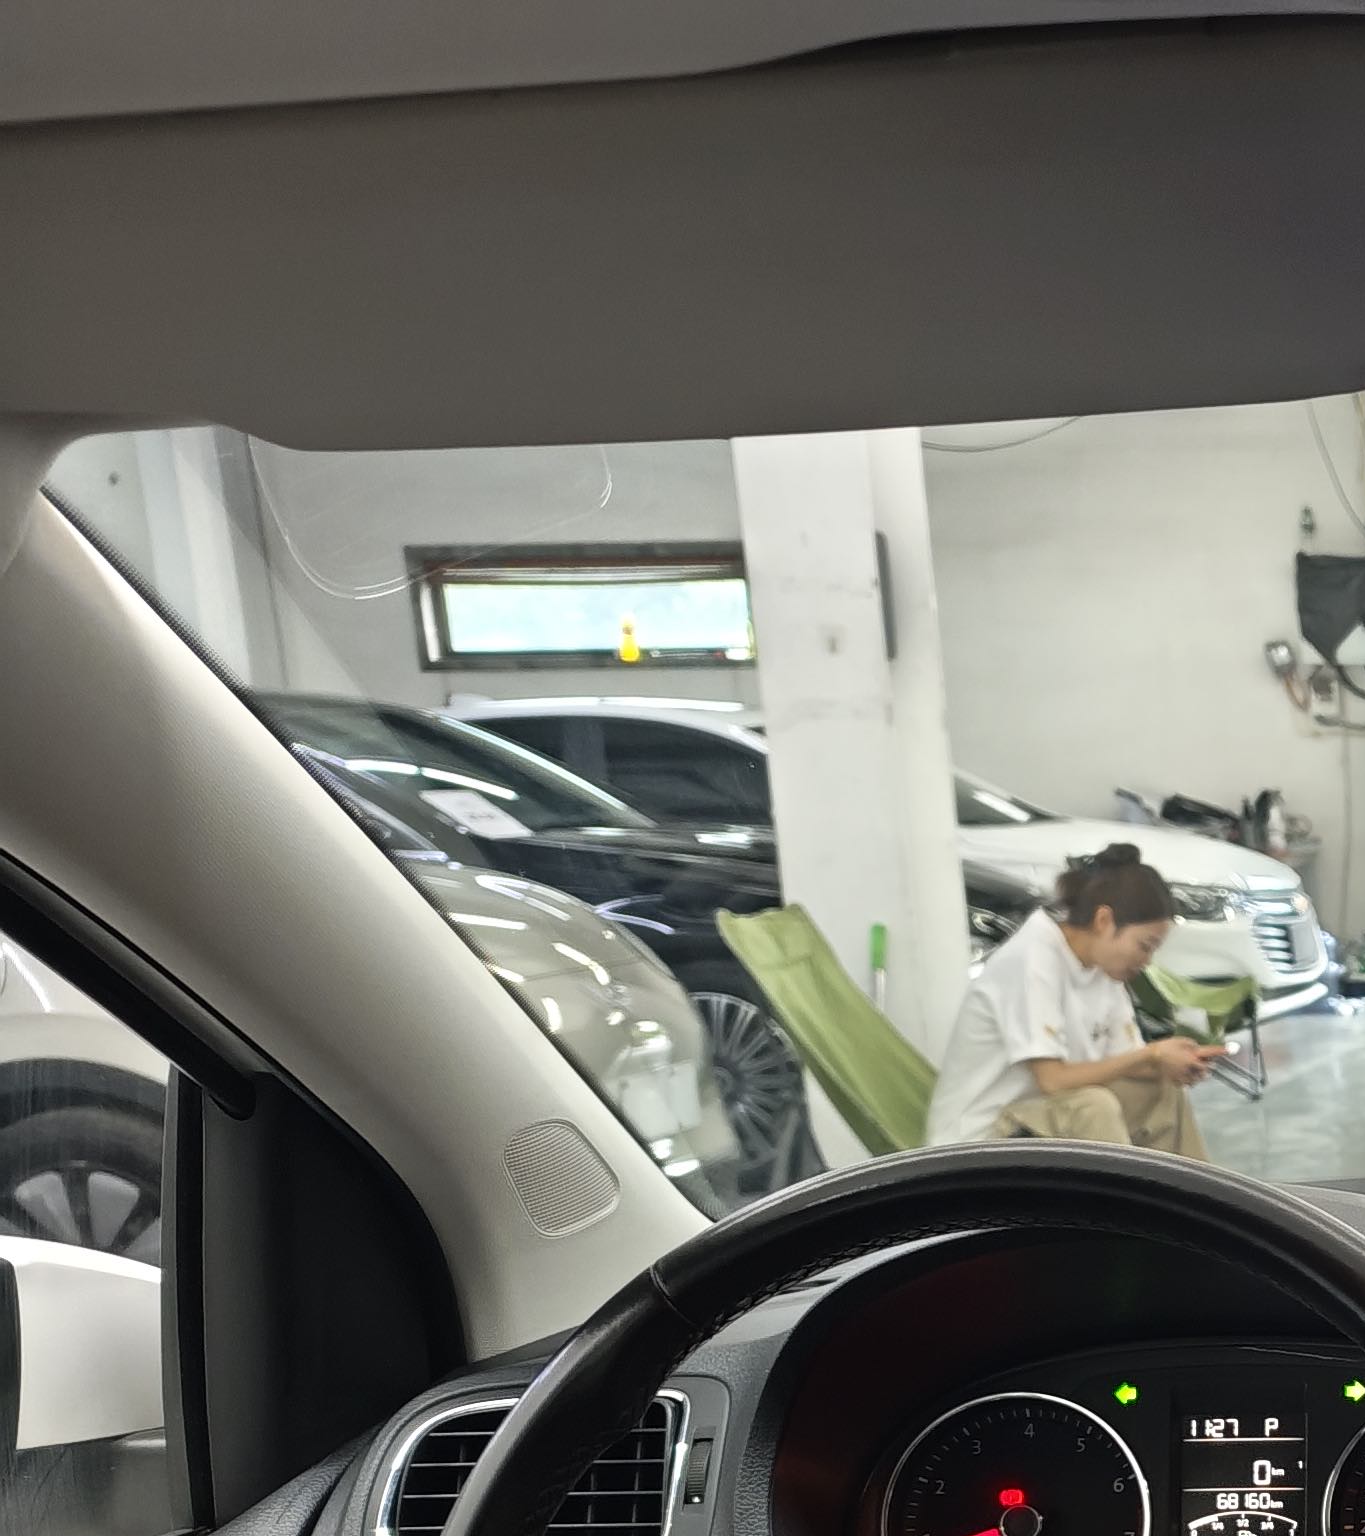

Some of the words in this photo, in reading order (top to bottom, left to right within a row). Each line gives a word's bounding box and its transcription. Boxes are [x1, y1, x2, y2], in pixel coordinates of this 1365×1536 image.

[1265, 1417, 1279, 1437] P
[936, 1480, 946, 1495] 2
[972, 1440, 982, 1455] 3
[1024, 1423, 1035, 1438] 4
[1076, 1437, 1086, 1452] 5
[1113, 1477, 1125, 1493] 6
